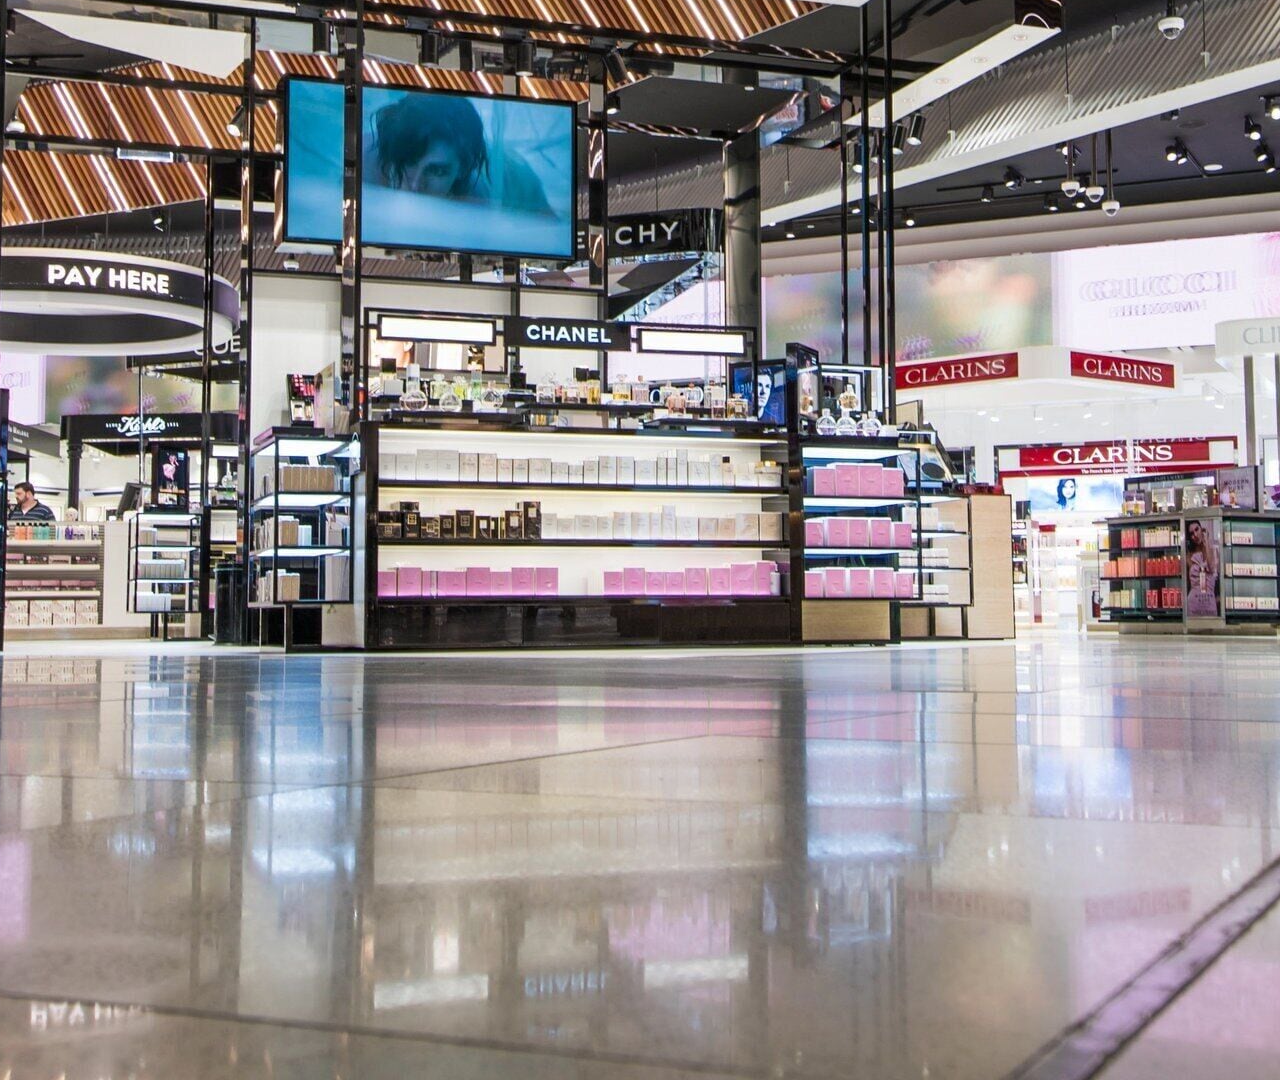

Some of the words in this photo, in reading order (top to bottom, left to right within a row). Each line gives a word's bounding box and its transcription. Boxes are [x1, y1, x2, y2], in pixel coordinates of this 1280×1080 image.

[47, 264, 102, 286] PAY
[108, 268, 170, 295] HERE
[526, 324, 612, 344] CHANEL
[905, 358, 1006, 384] CLARINS
[1083, 358, 1163, 383] CLARINS
[118, 416, 166, 436] Kiehl's
[1053, 444, 1173, 465] CLARINS
